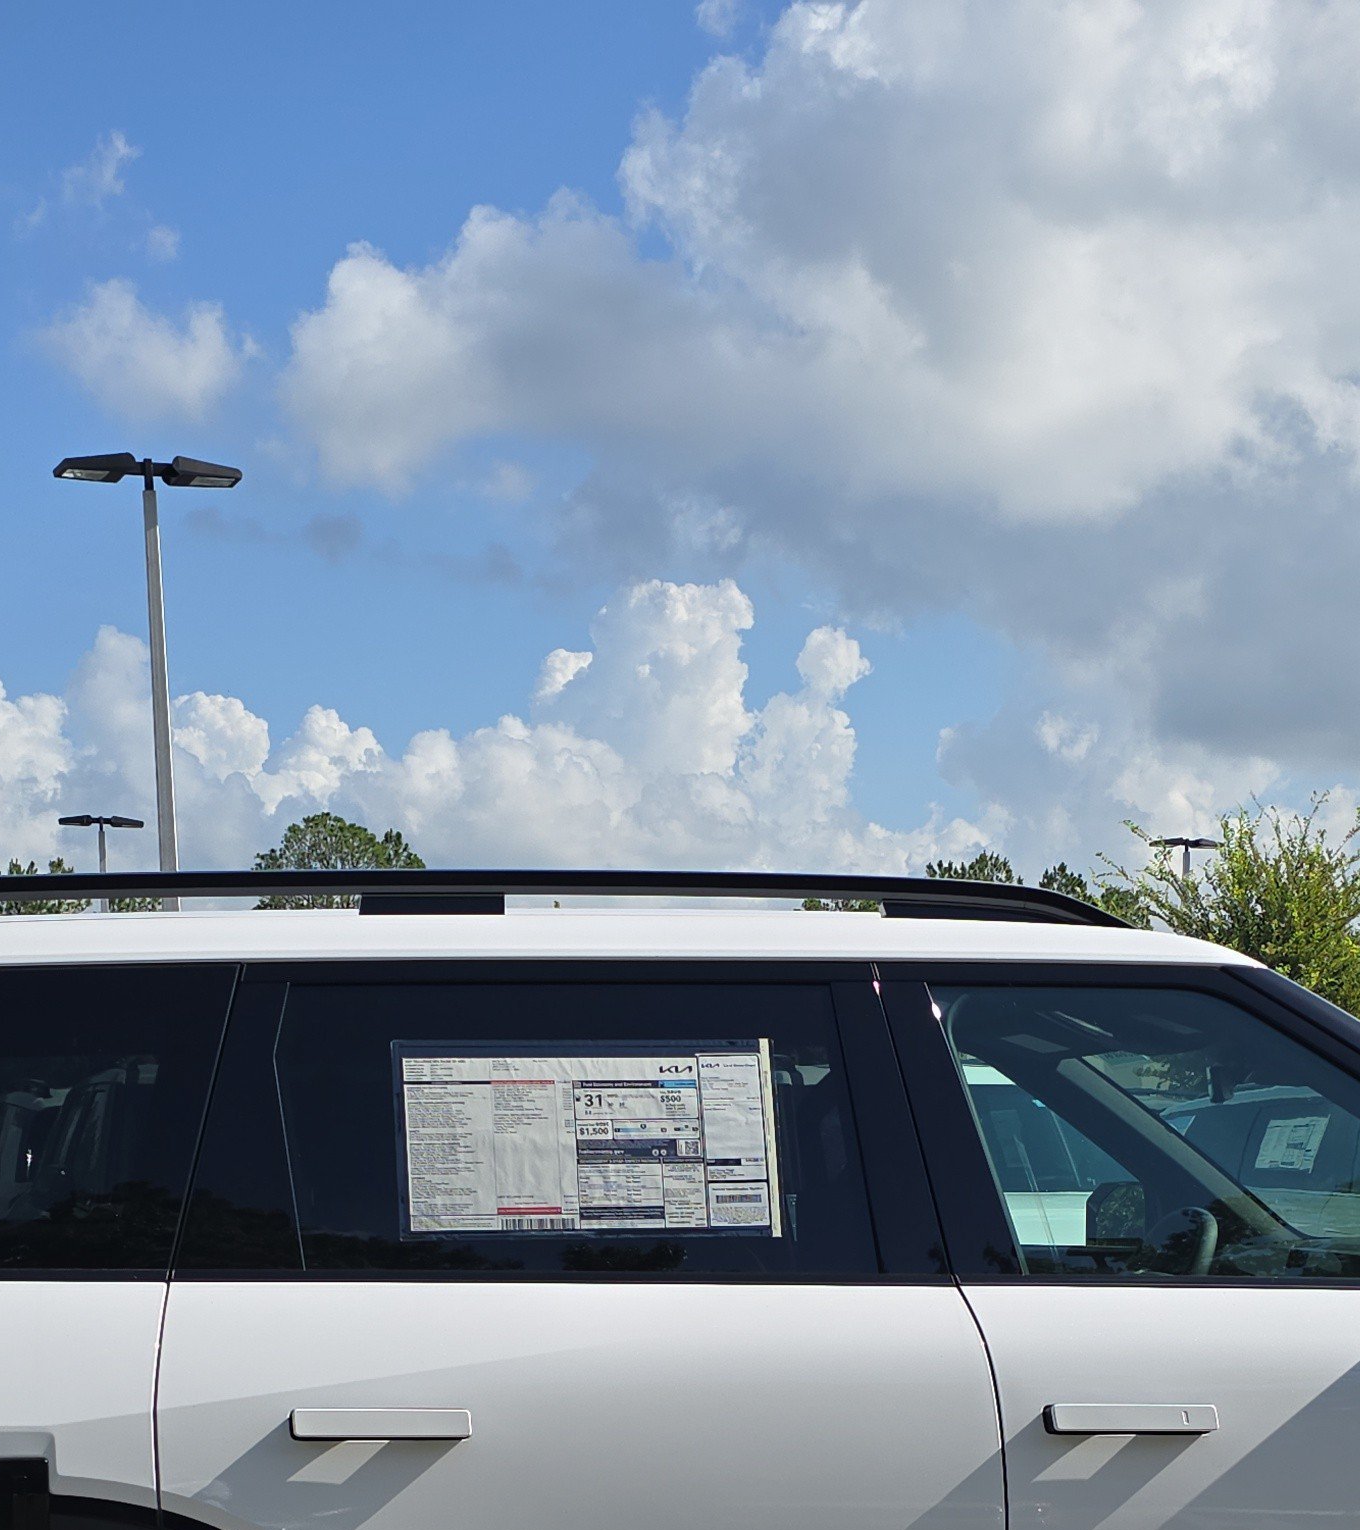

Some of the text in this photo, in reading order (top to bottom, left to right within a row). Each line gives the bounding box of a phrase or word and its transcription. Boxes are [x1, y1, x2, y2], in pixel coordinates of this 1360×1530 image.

[659, 1065, 693, 1074] KIA
[584, 1094, 603, 1107] 31
[660, 1095, 681, 1103] $500
[579, 1127, 609, 1137] $1,500
